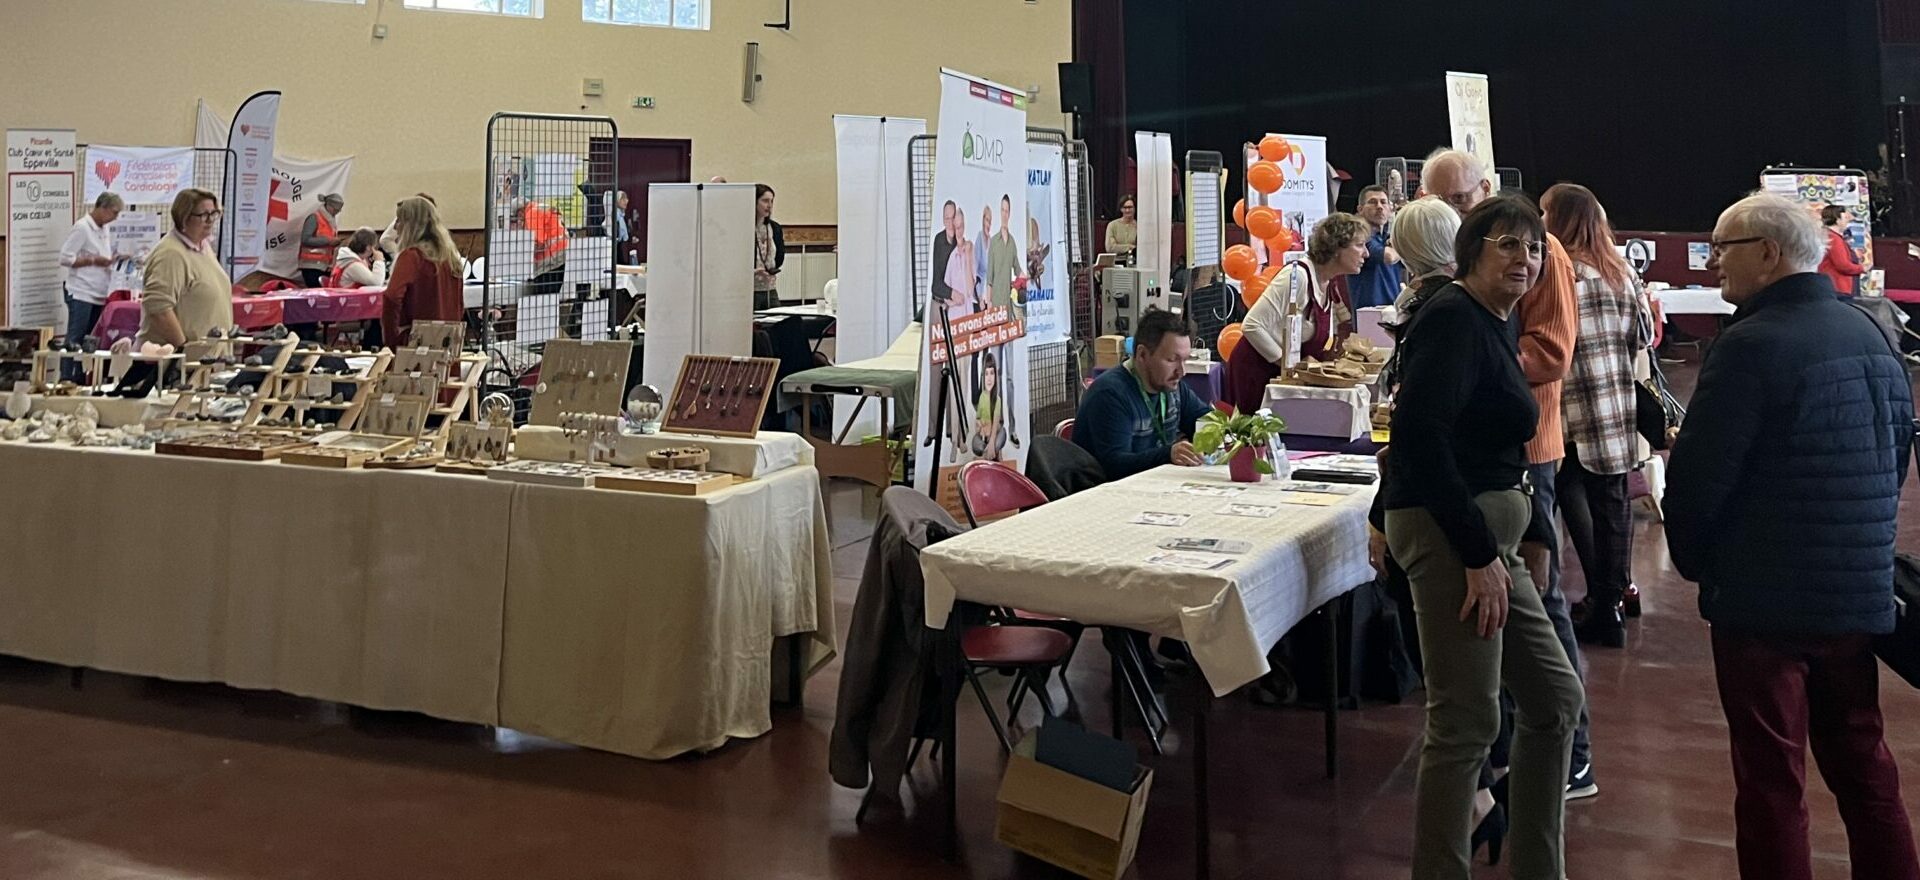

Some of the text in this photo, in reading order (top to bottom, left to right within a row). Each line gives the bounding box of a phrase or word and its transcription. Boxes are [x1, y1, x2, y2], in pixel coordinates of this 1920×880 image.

[8, 147, 24, 157] Club
[54, 147, 74, 157] Santé
[127, 160, 176, 171] Fédération
[124, 180, 178, 194] Cardiologie
[13, 212, 28, 220] SON
[958, 317, 982, 333] avons
[983, 306, 1008, 326] décidé
[932, 344, 946, 361] de
[954, 341, 966, 355] ous
[999, 325, 1008, 342] la
[1008, 322, 1018, 336] vie
